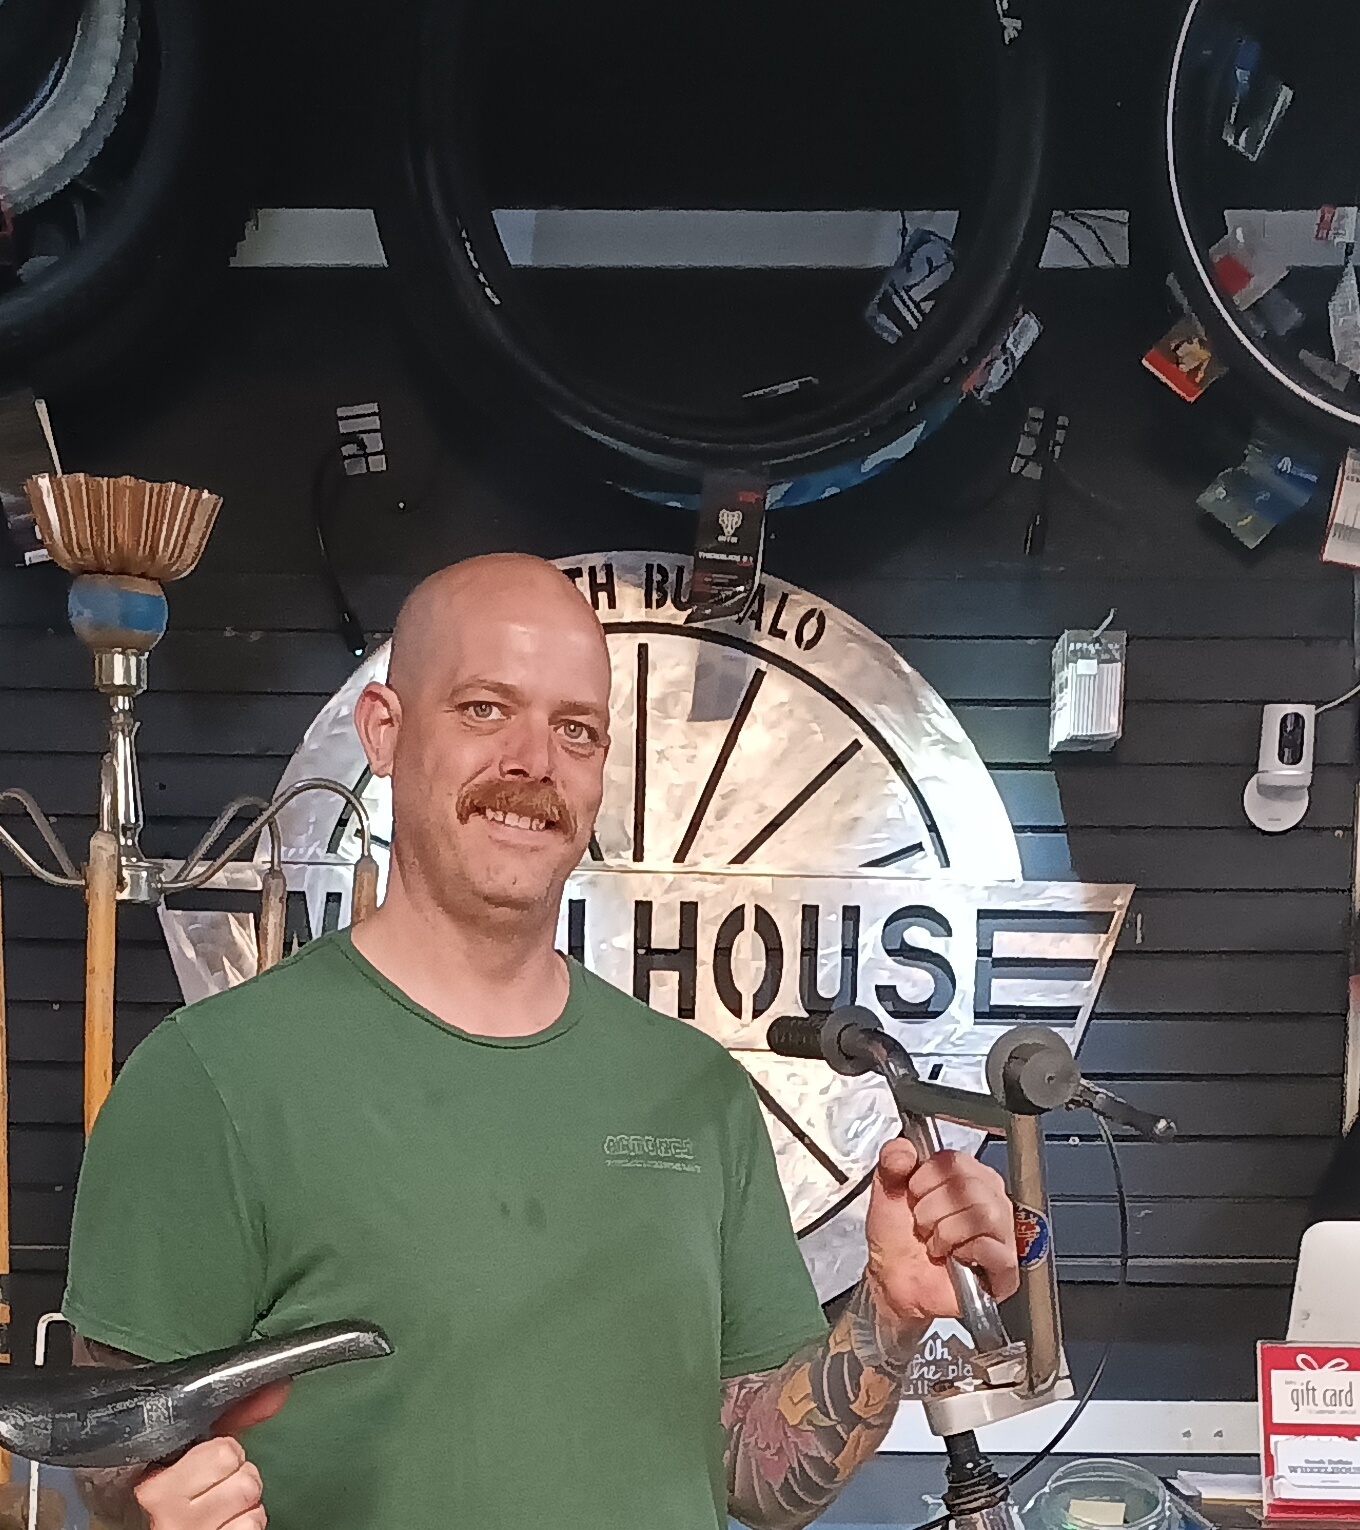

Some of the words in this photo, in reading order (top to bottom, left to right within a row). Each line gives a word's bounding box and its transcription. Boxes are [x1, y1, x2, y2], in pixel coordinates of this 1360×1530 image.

[643, 562, 827, 652] BUALO
[924, 1339, 953, 1361] Oh
[1290, 1380, 1319, 1412] gift
[1322, 1381, 1354, 1408] card
